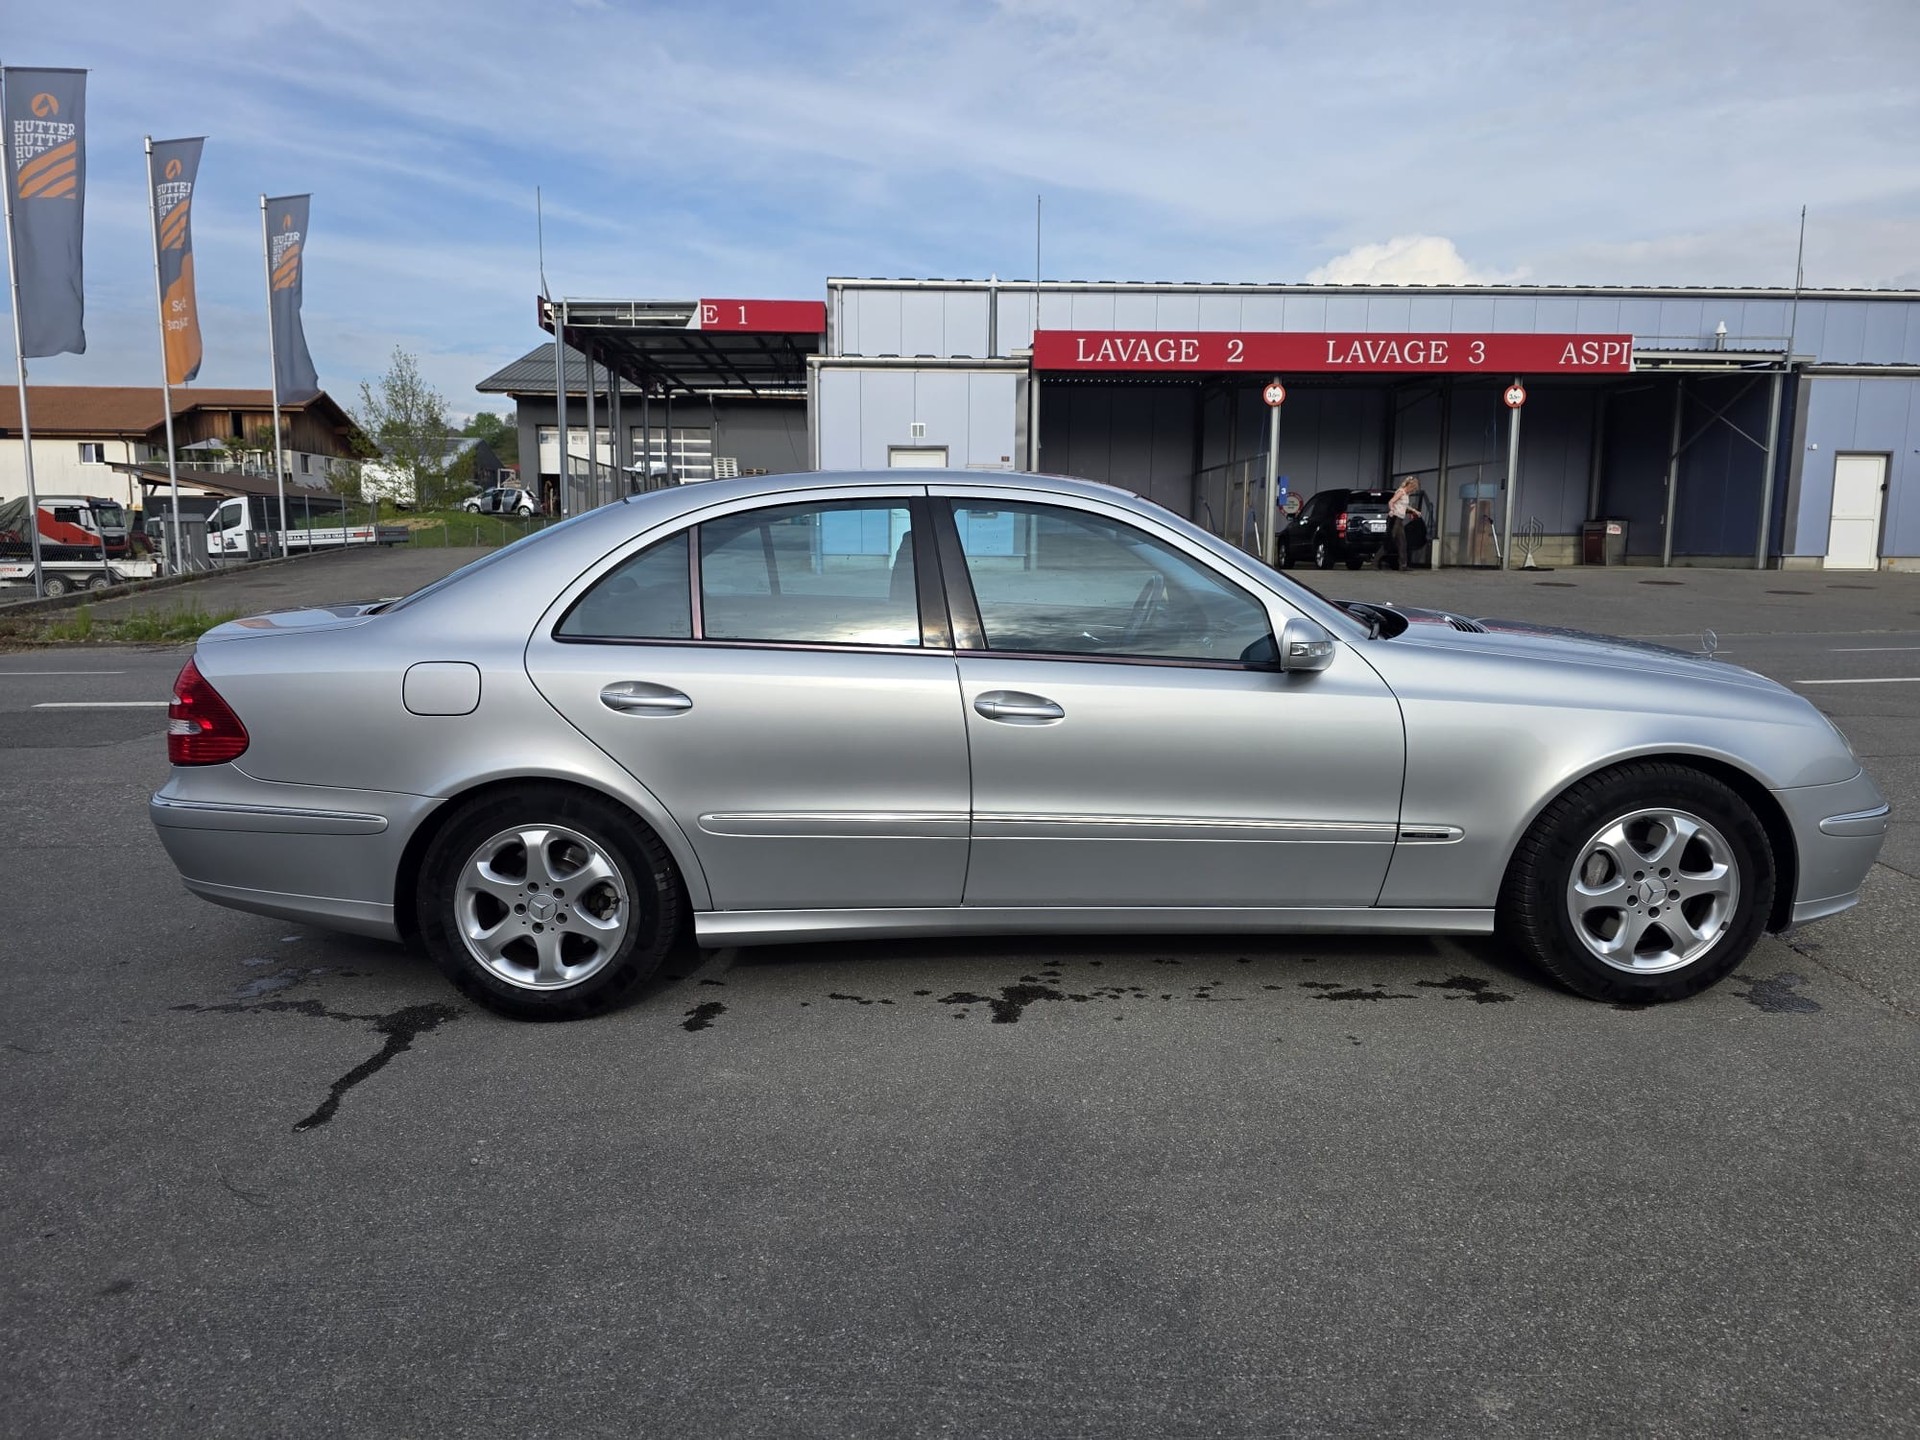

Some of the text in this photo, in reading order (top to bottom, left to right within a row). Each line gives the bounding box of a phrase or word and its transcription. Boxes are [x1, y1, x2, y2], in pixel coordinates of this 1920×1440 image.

[14, 120, 75, 135] HUTTER
[14, 133, 71, 147] HUTTE
[701, 304, 748, 325] E 1
[1076, 338, 1244, 363] LAVAGE 2
[1326, 340, 1486, 364] LAVAGE 3
[1558, 342, 1630, 365] ASPI
[1281, 487, 1287, 495] 3
